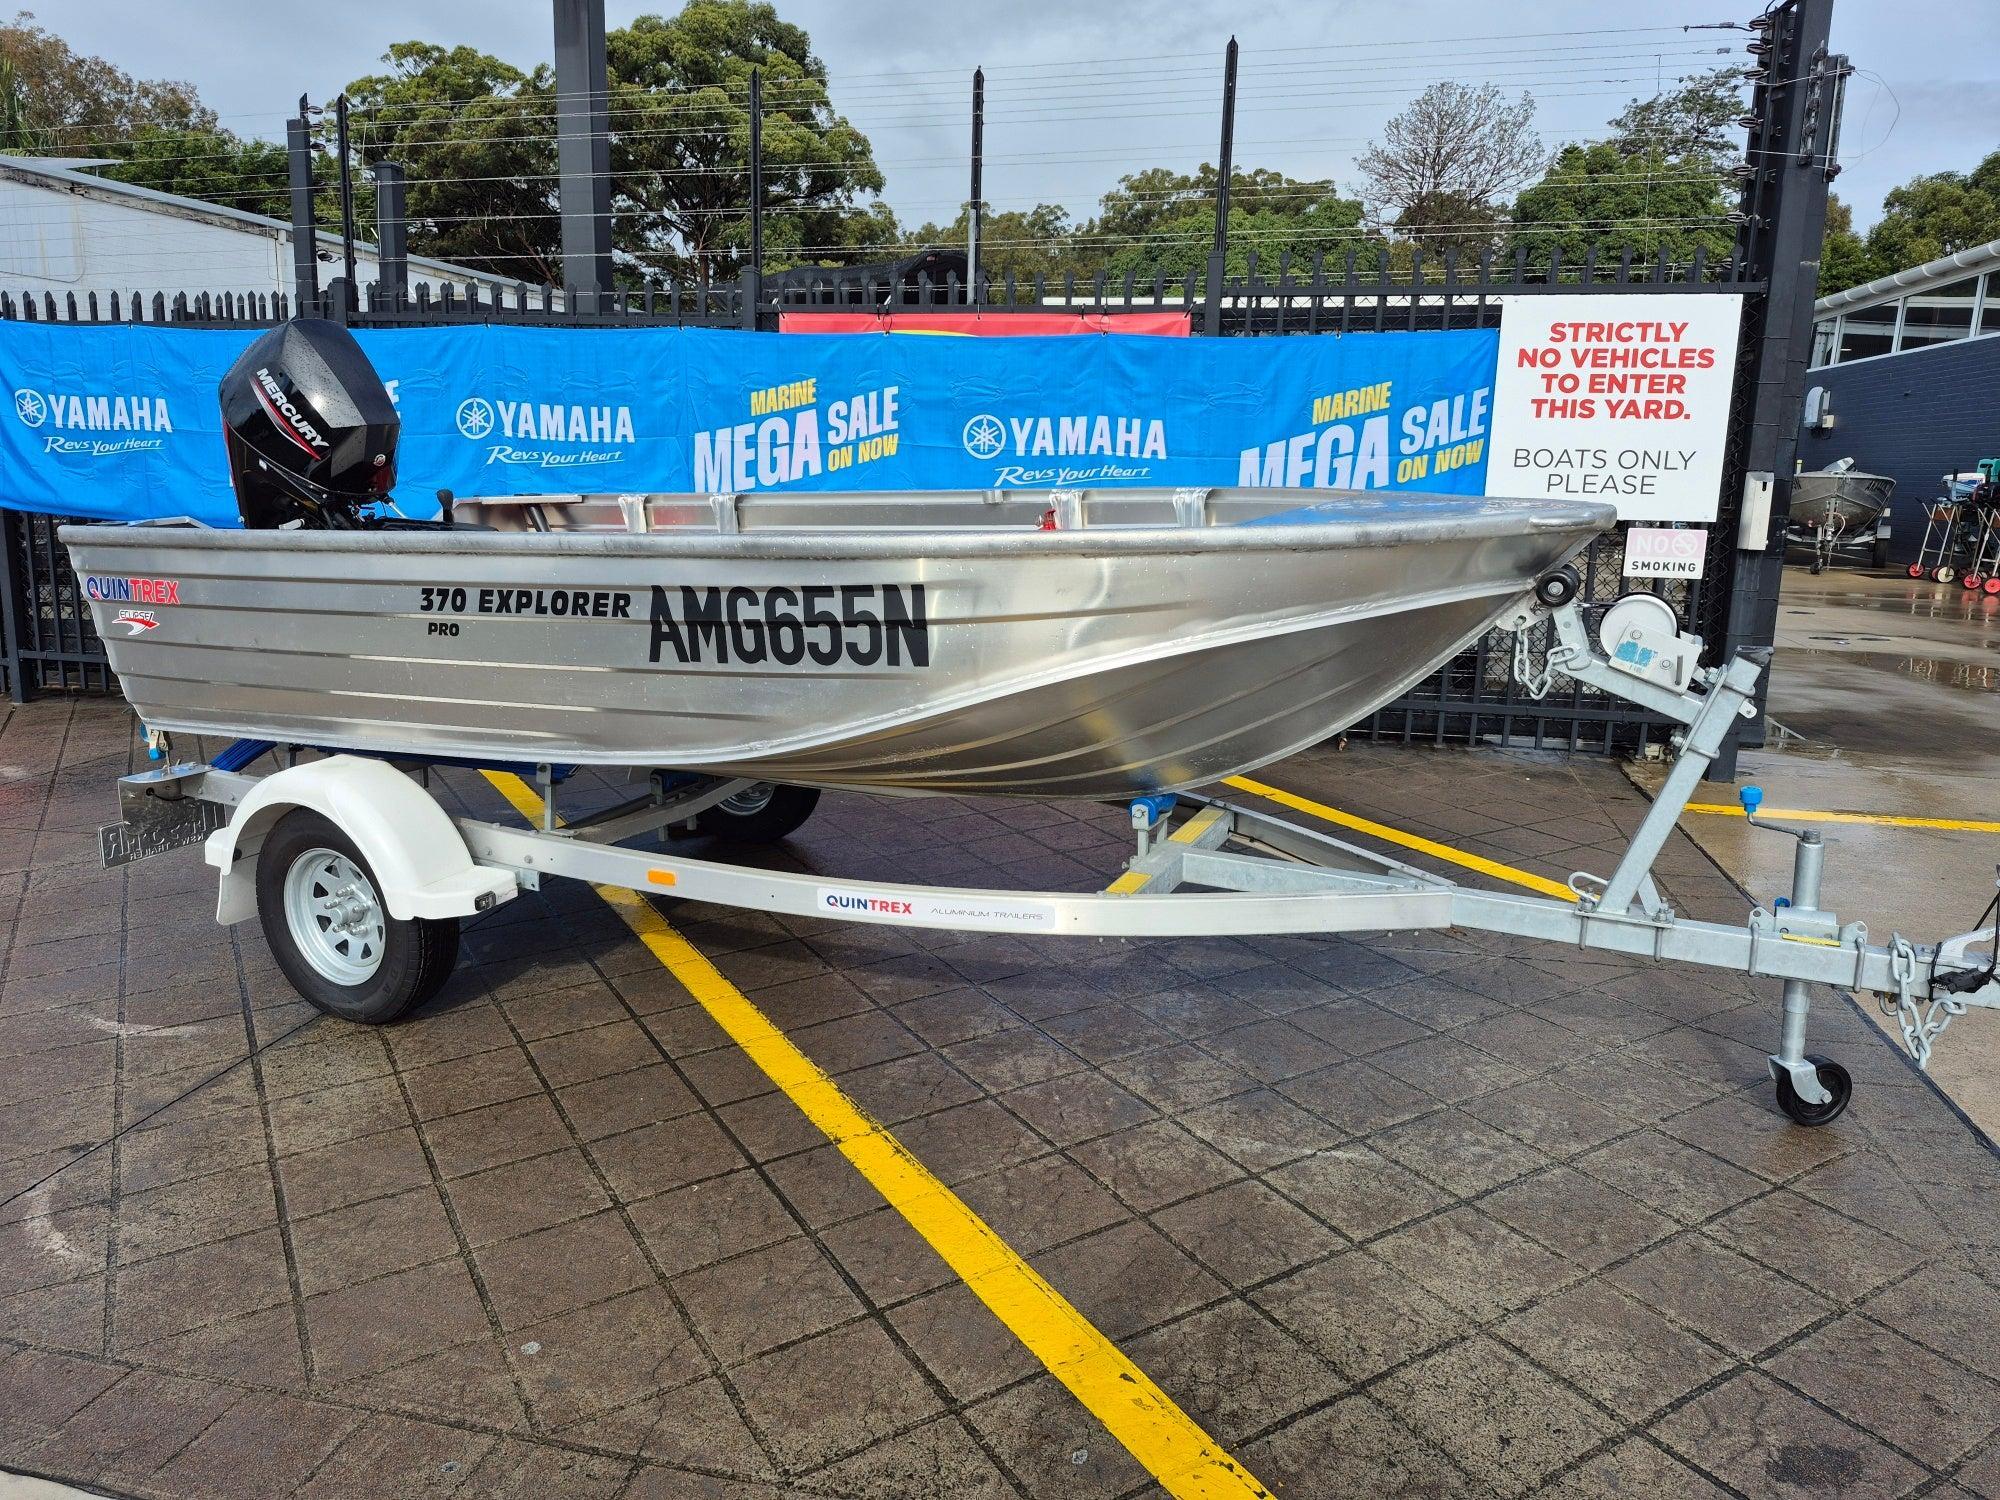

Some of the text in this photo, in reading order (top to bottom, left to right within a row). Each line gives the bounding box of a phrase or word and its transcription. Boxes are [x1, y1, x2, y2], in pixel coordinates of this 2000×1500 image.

[1549, 322, 1688, 342] STRICTLY
[1517, 348, 1715, 368] NO VEHICLES
[1541, 373, 1686, 394] TO ENTER
[256, 368, 329, 447] MERCURY
[751, 378, 817, 416] MARINE
[1312, 381, 1393, 425] MARINE
[1531, 399, 1691, 419] THIS YARD.
[48, 395, 172, 432] YAMAHA
[496, 400, 635, 443] YAMAHA
[827, 386, 899, 446] SALE
[1399, 387, 1489, 454] SALE
[43, 436, 163, 455] Revs Your Heart
[694, 408, 821, 492] MEGA
[1011, 415, 1167, 459] YAMAHA
[486, 446, 623, 468] Revs Your Heart
[828, 434, 898, 472] ON NOW
[1397, 438, 1485, 484] ON NOW
[1513, 448, 1696, 470] BOATS ONLY
[994, 465, 1149, 487] Revs Your Heart
[1547, 474, 1657, 494] PLEASE
[1637, 535, 1669, 553] NO
[1631, 560, 1696, 572] SMOKING
[86, 575, 180, 605] QUINTREX
[421, 588, 631, 618] 370 EXPLORER
[428, 622, 459, 636] PRO
[649, 584, 930, 667] AMG655N
[826, 894, 912, 915] QUINTREX
[931, 907, 1043, 921] ALUMINIUM TRAILERS
